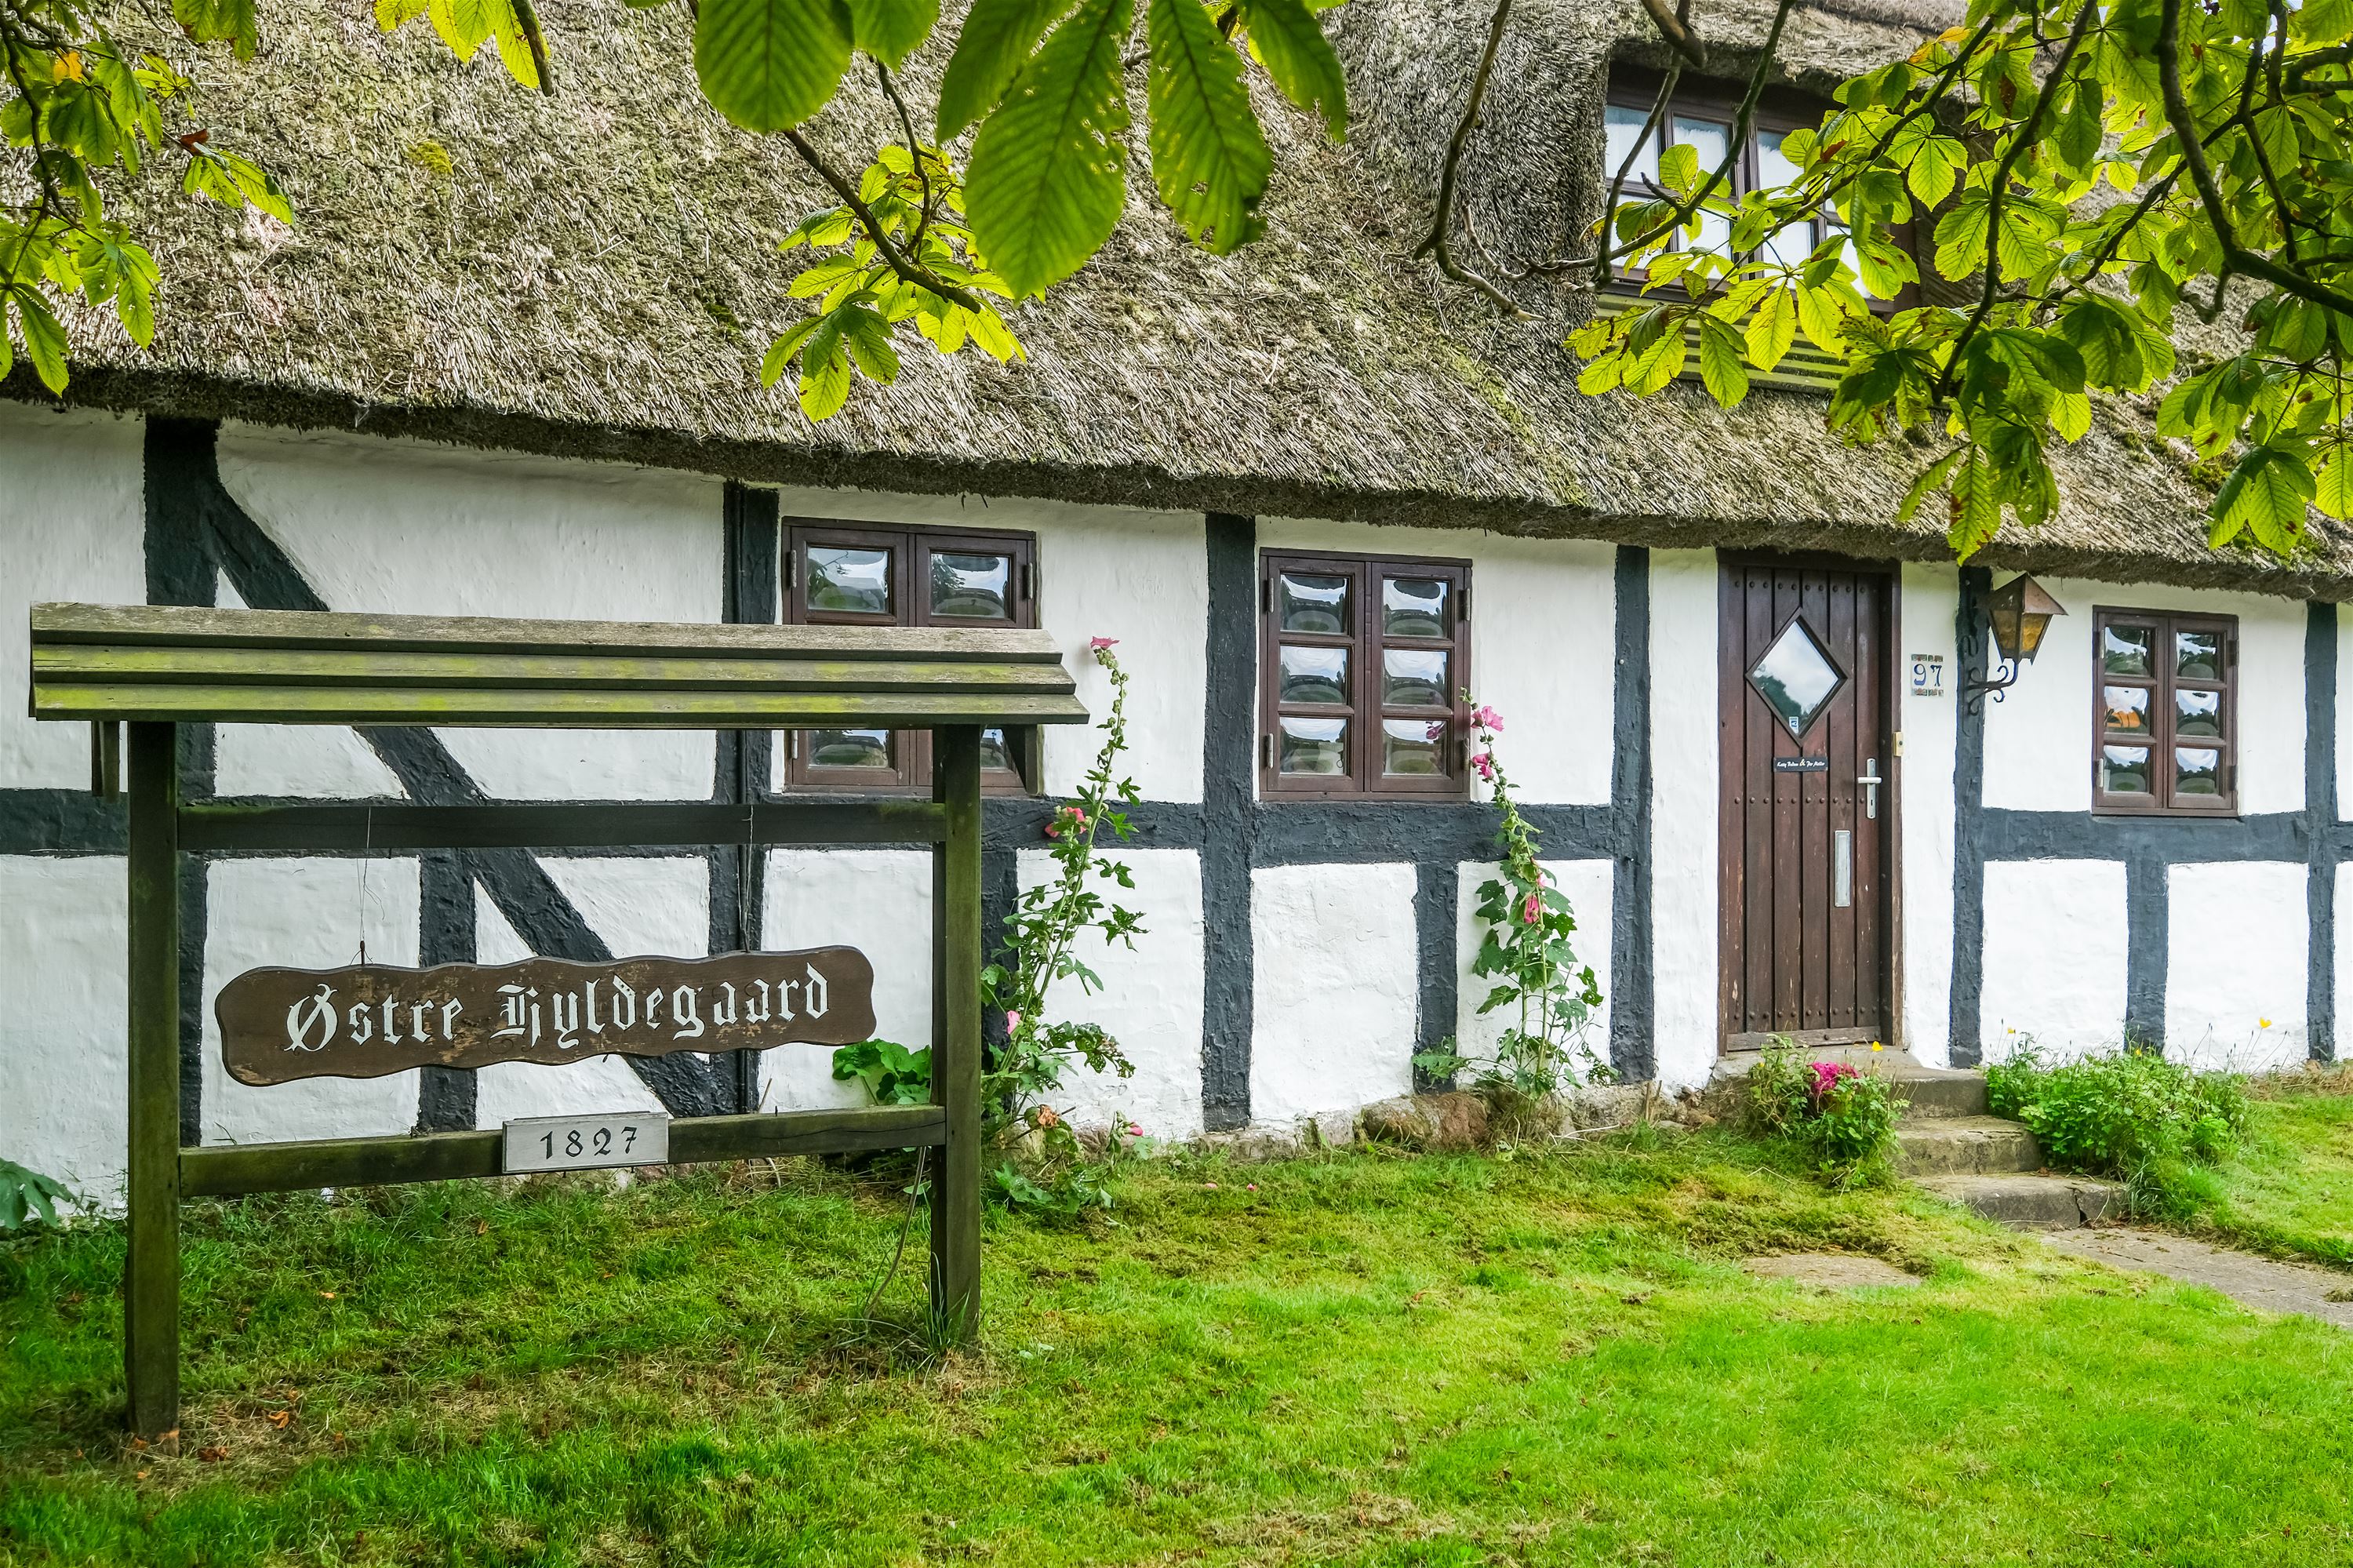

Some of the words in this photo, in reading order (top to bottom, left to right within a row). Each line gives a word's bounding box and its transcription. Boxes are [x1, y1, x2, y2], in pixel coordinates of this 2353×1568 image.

[1913, 664, 1943, 687] 97
[283, 982, 465, 1053] Østre
[489, 962, 831, 1050] Hyldegaard
[539, 1126, 638, 1160] 1827
